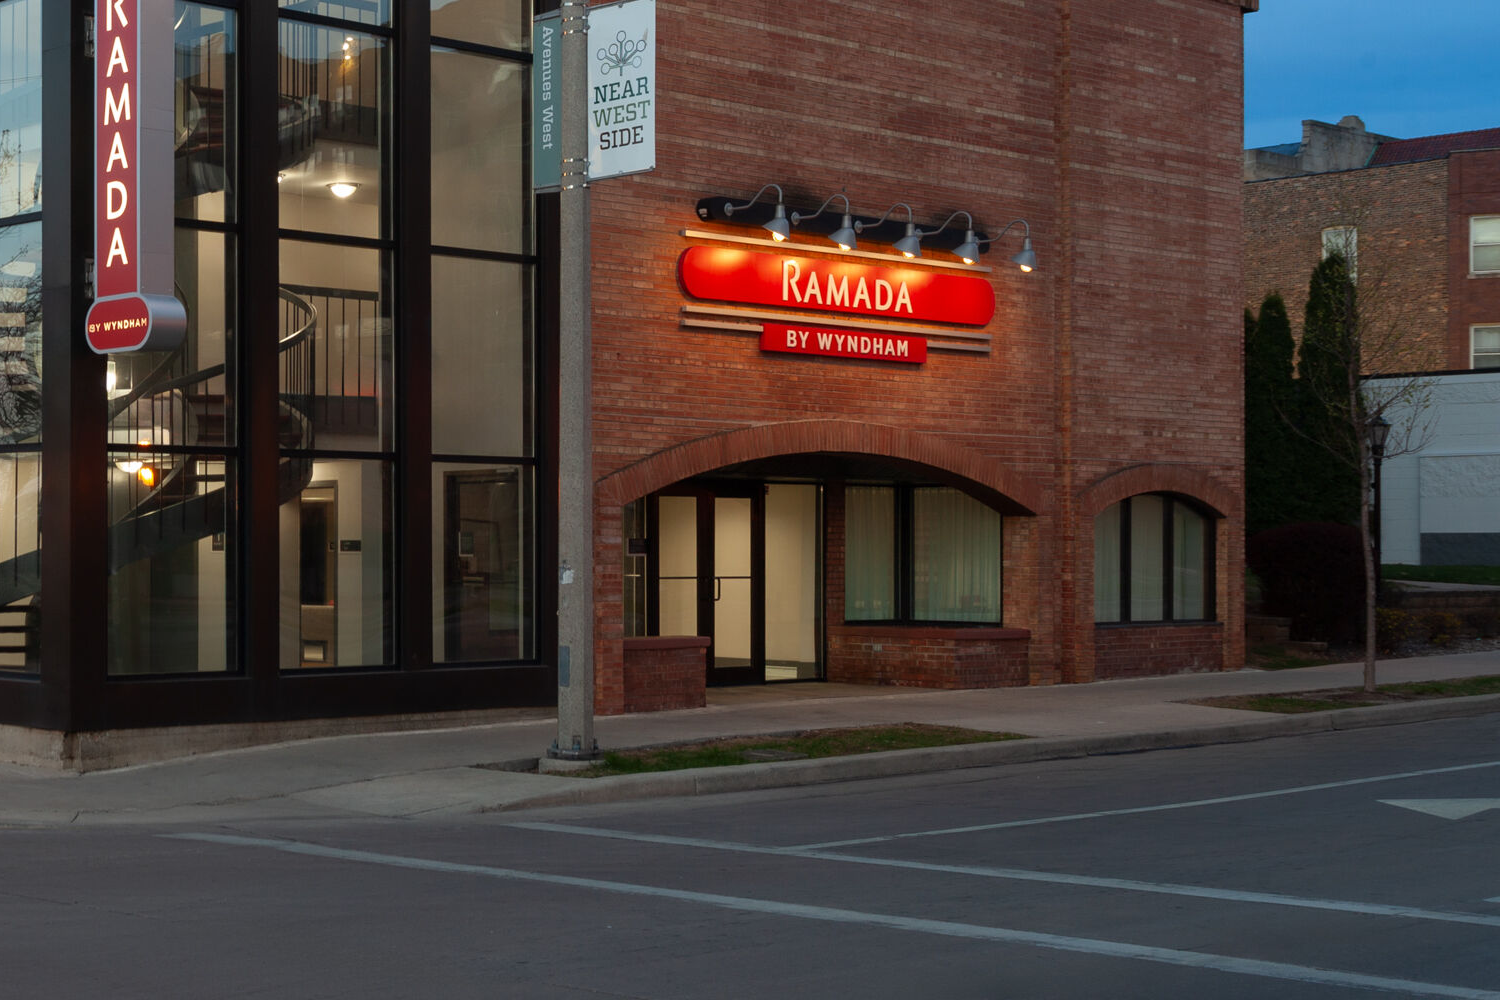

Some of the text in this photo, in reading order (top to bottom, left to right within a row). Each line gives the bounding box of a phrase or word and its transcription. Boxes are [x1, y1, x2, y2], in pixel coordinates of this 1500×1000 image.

[542, 26, 553, 149] Avenues West
[594, 76, 649, 104] NEAR
[593, 100, 650, 127] WEST
[600, 125, 643, 150] SIDE
[782, 260, 913, 314] RAMADA
[88, 317, 147, 332] BY WYNDHAM
[786, 330, 909, 357] BY WYNDHAM
